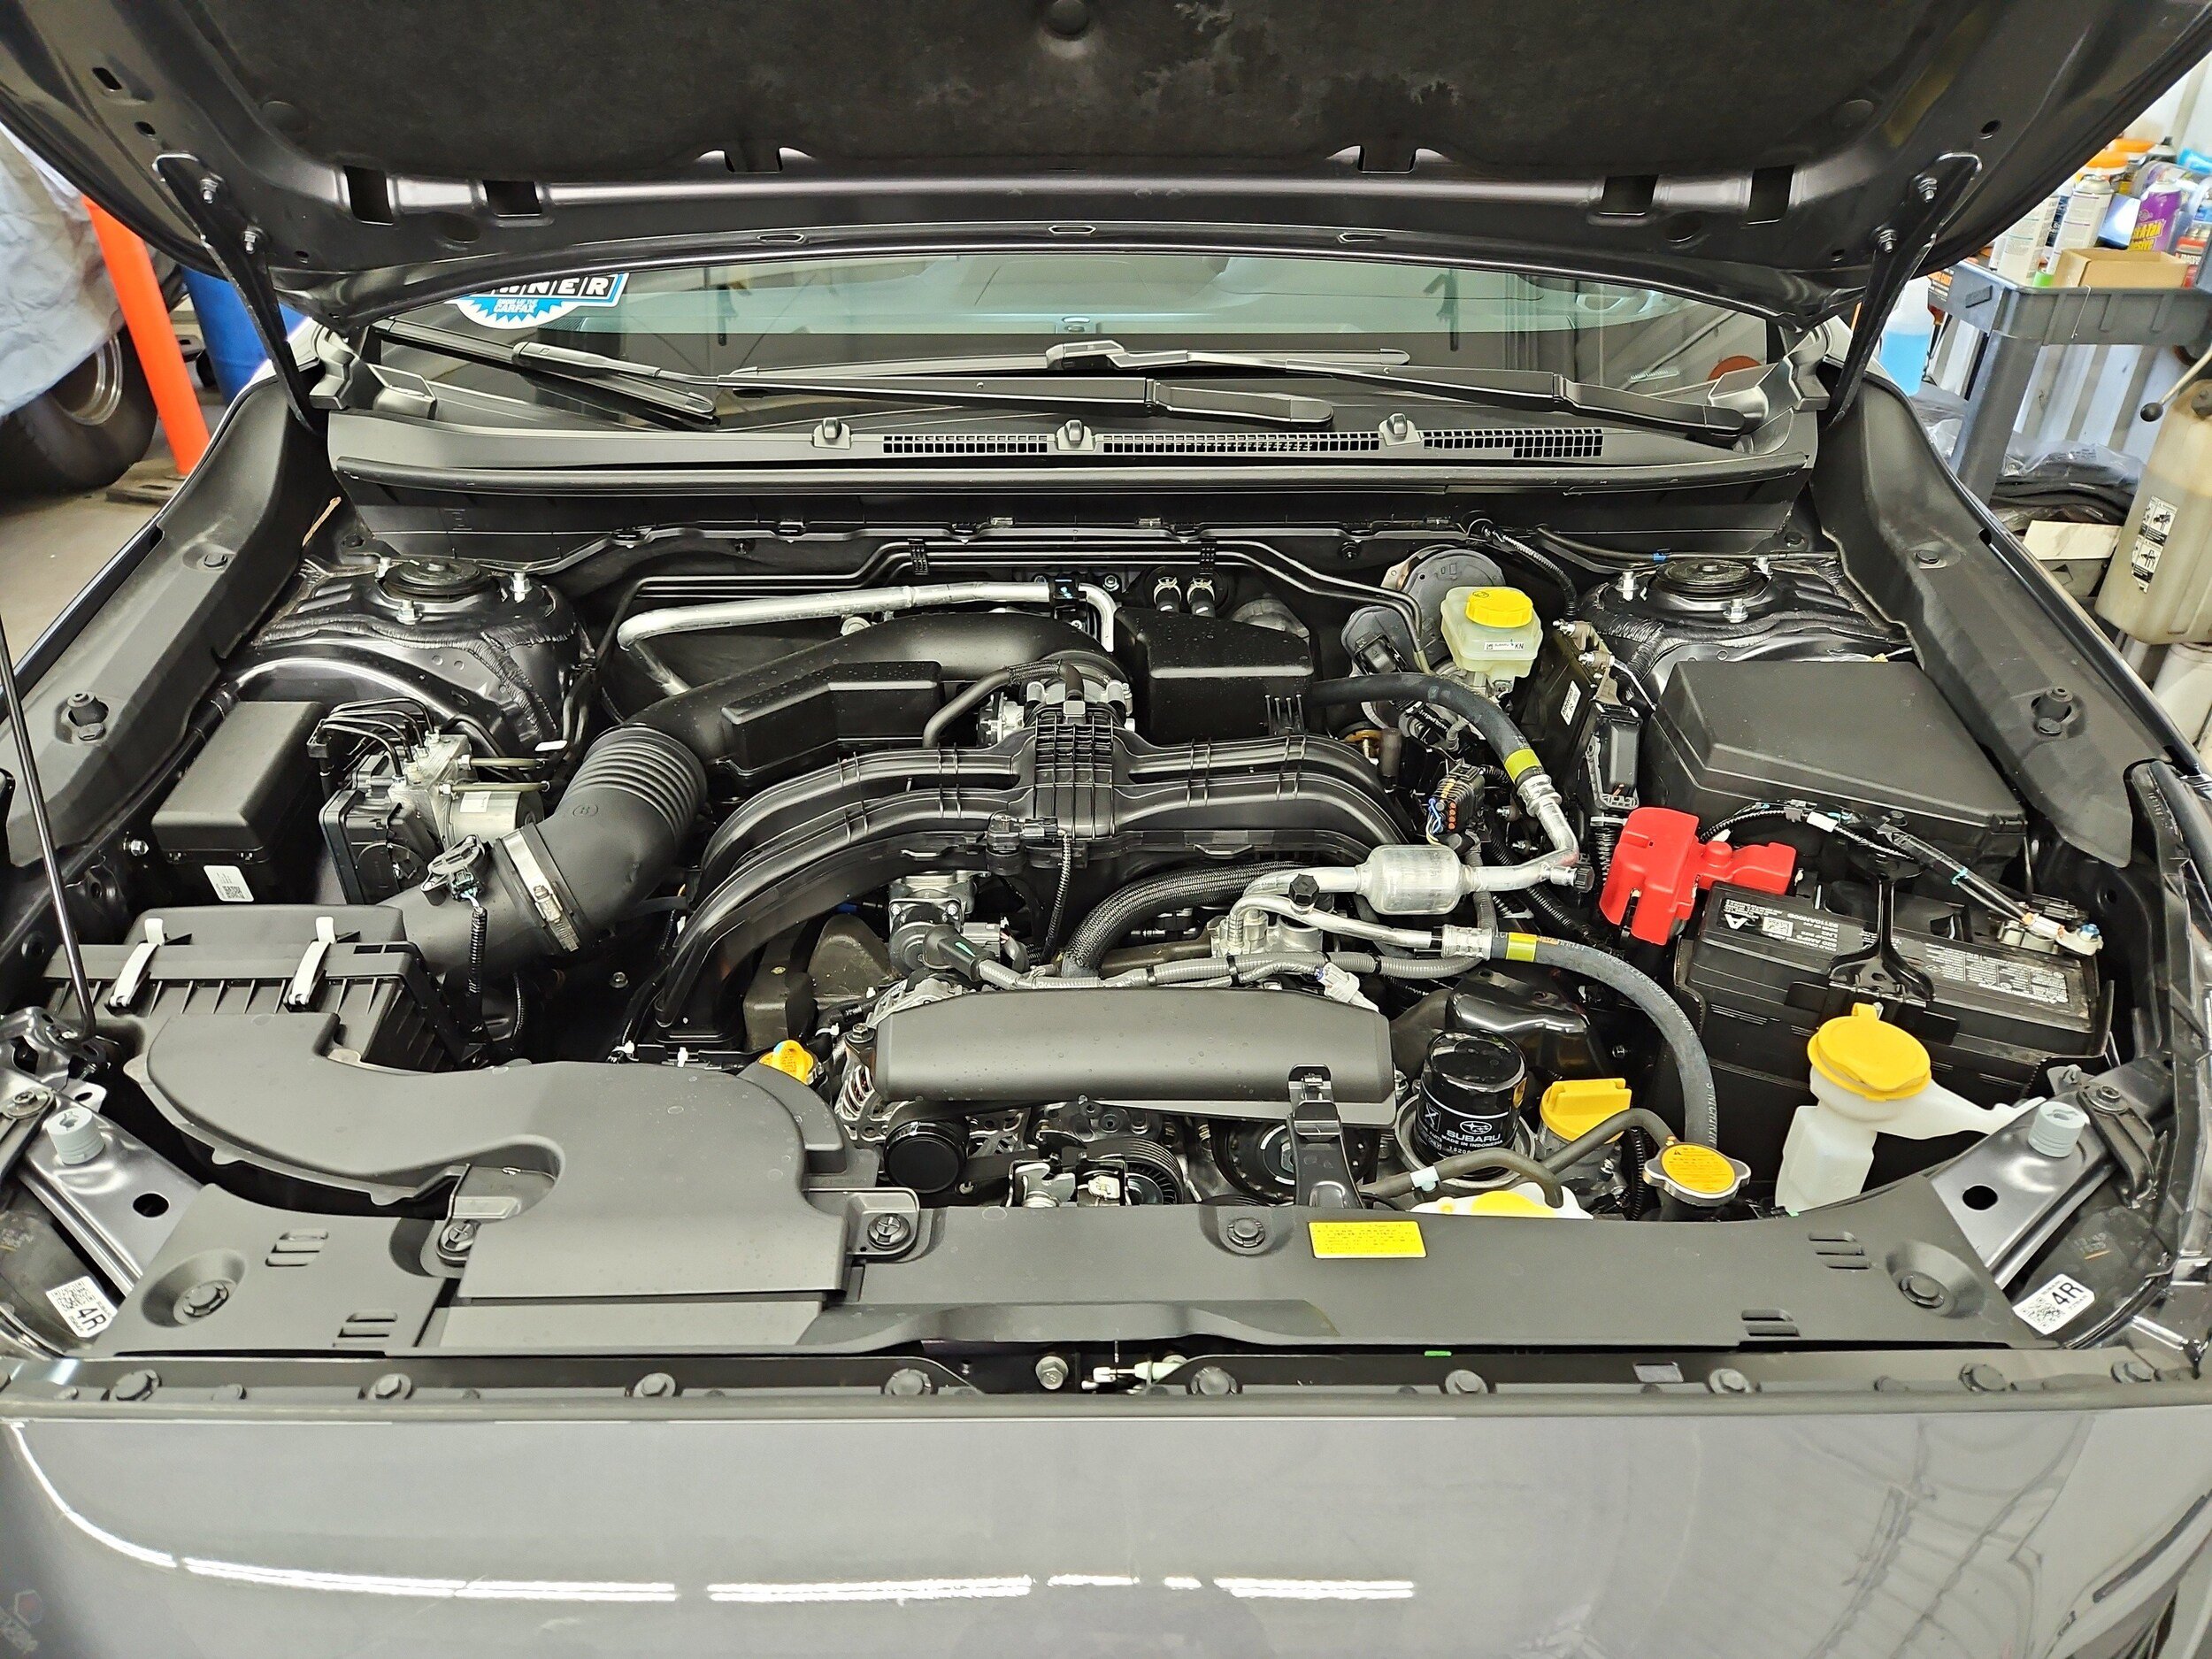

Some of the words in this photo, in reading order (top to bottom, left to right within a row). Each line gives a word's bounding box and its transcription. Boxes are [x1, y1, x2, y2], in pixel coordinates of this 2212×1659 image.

[493, 303, 536, 313] CARFAX
[1796, 934, 1822, 944] AMPS
[1440, 1134, 1459, 1146] MADE
[1470, 1139, 1503, 1148] INDONESIA
[1446, 1129, 1502, 1143] SUBARU
[2051, 1282, 2085, 1305] 4R
[77, 1308, 107, 1331] 4R
